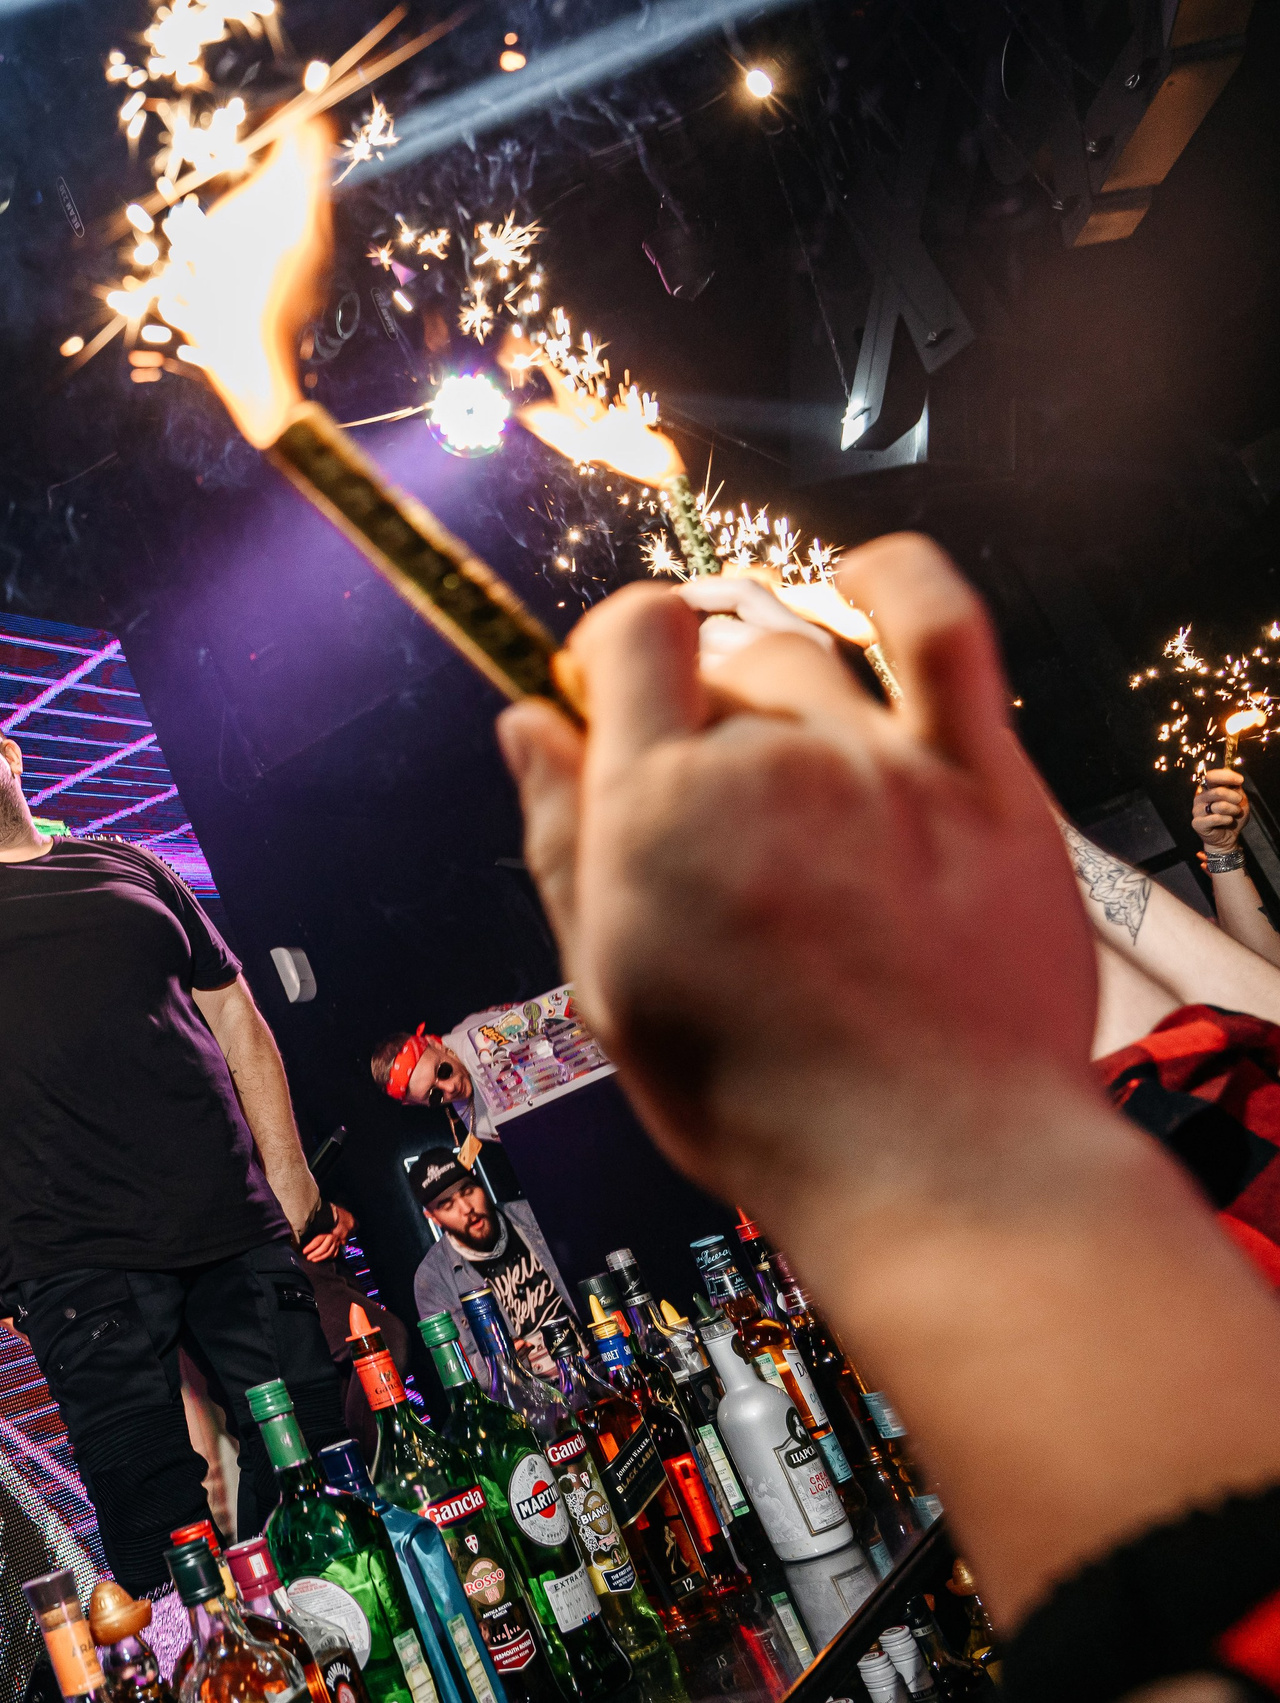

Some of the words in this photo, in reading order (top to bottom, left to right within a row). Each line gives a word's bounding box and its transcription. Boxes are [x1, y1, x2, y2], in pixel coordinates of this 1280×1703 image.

[66, 202, 80, 229] BEAM
[374, 1384, 403, 1396] Ganc
[547, 1433, 586, 1463] Gancia
[616, 1456, 635, 1481] JOHNNIE
[616, 1467, 639, 1494] BLACK
[637, 1447, 656, 1469] LABE
[809, 1472, 828, 1486] CREA
[810, 1480, 833, 1495] LIQUE
[424, 1489, 484, 1524] Gancia
[519, 1486, 559, 1518] MARTIN
[580, 1503, 610, 1525] BIANCO
[464, 1568, 505, 1596] ROSSO
[554, 1574, 579, 1592] EXTRA
[682, 1577, 695, 1592] 12
[325, 1659, 352, 1689] BOMBAY
